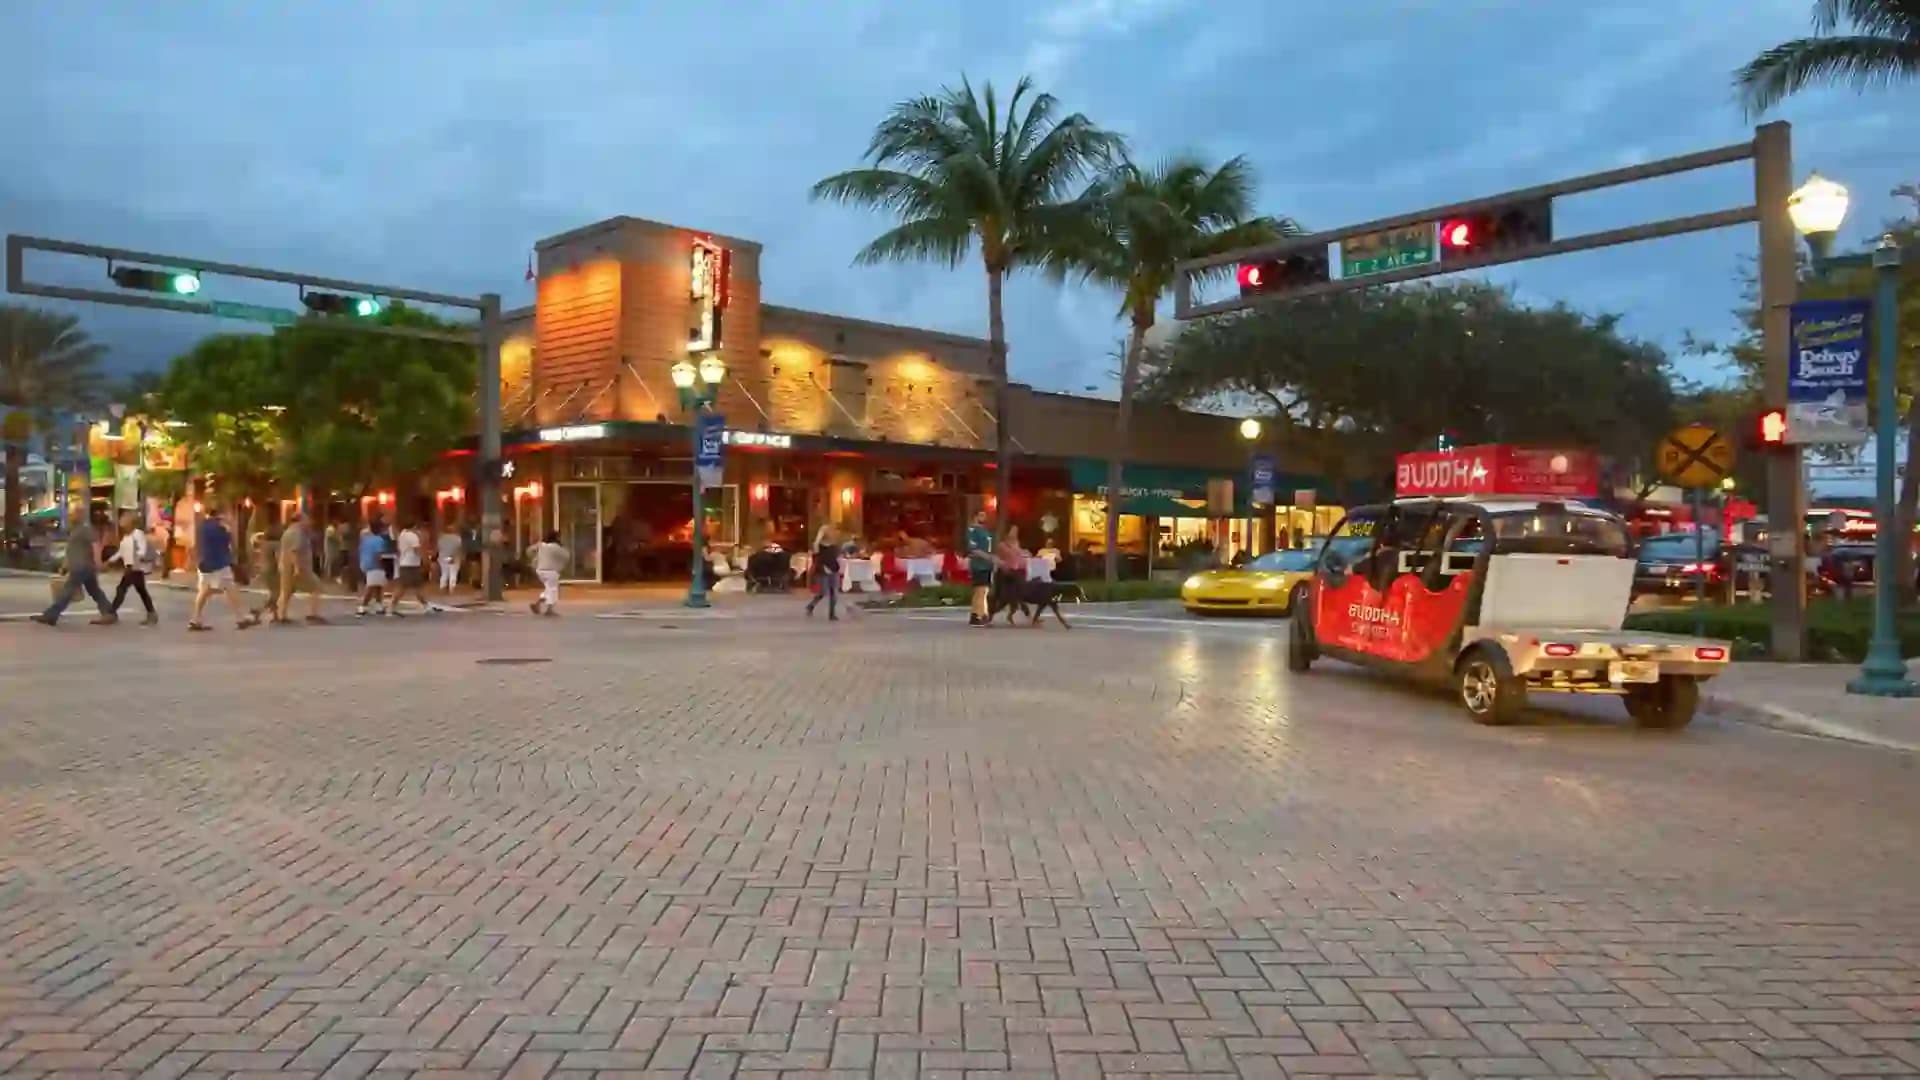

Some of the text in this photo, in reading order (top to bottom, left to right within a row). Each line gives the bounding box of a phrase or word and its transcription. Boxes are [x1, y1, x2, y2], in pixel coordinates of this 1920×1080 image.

[1387, 252, 1411, 268] AVE
[1398, 457, 1488, 489] BUDDHA
[1347, 603, 1400, 626] BUDDHA
